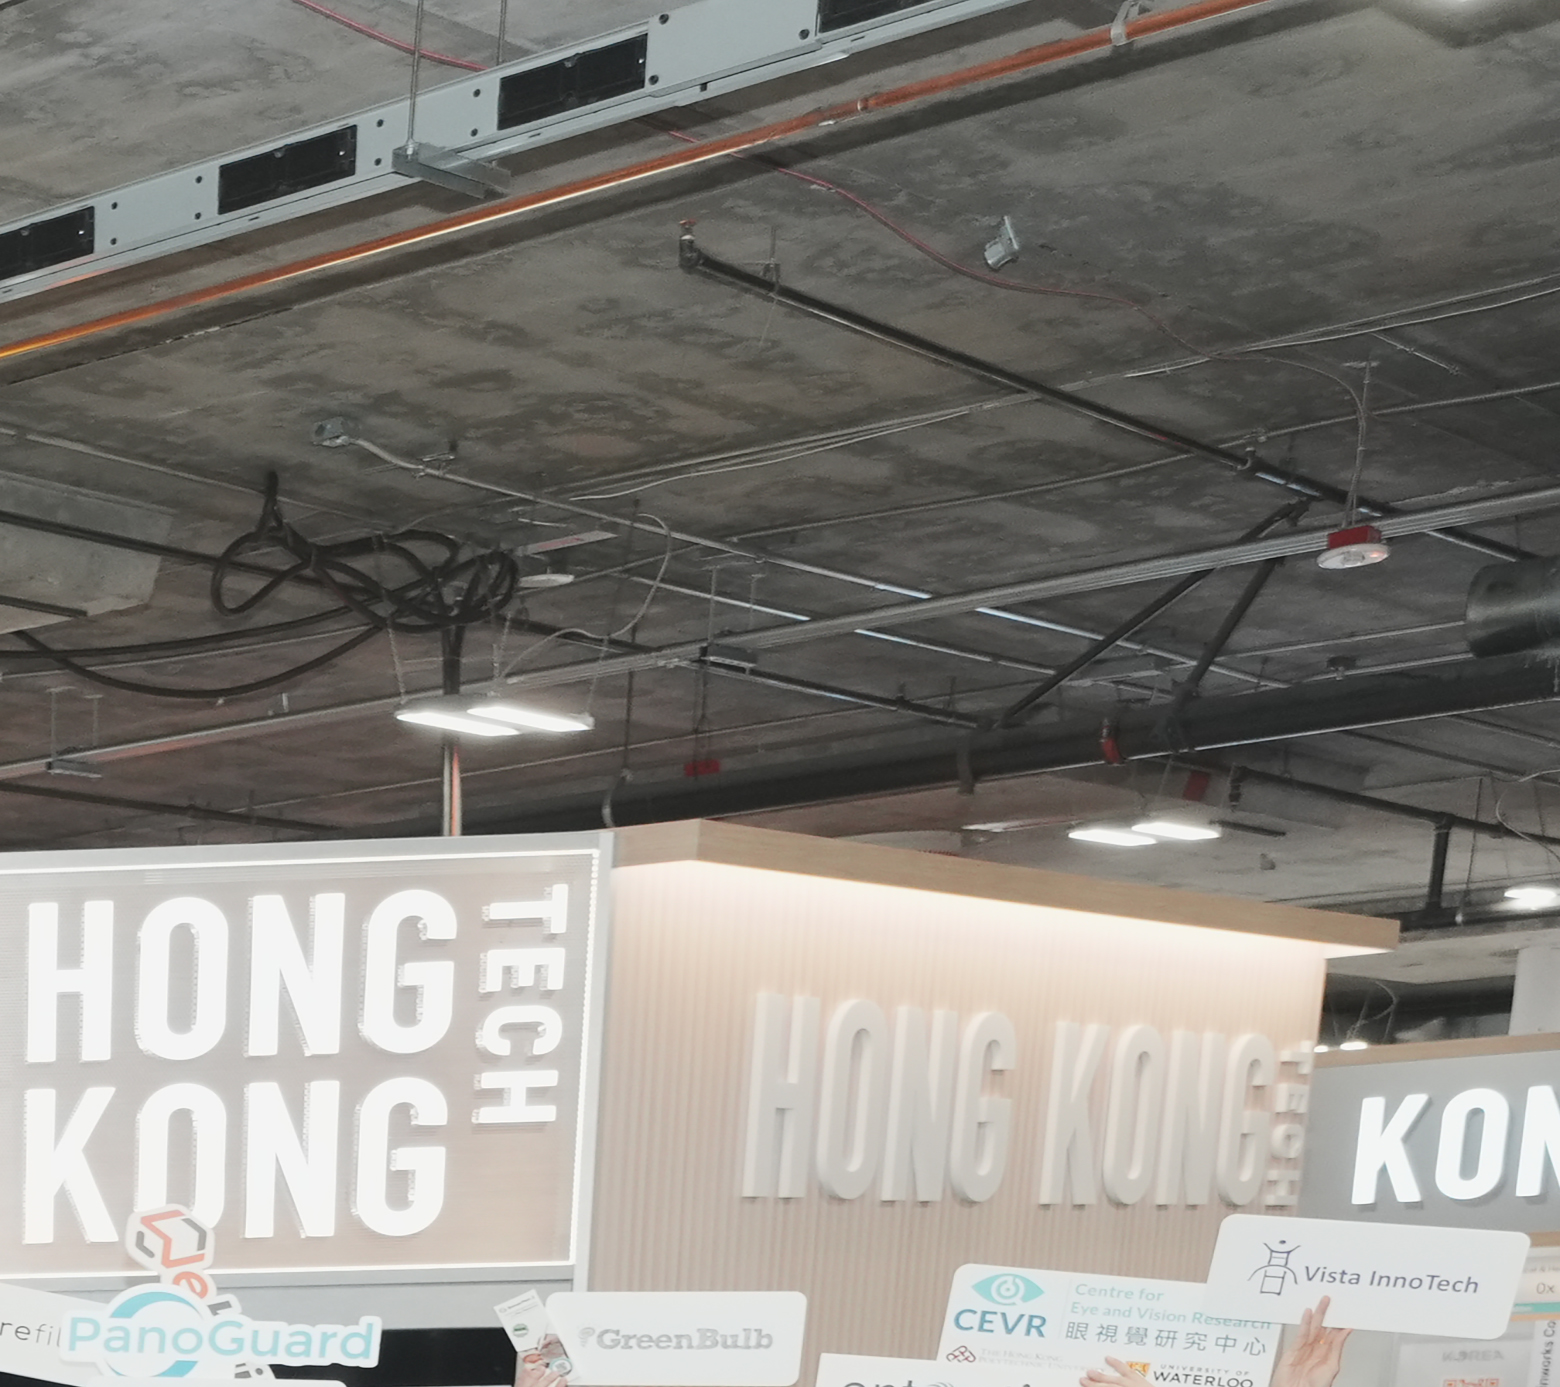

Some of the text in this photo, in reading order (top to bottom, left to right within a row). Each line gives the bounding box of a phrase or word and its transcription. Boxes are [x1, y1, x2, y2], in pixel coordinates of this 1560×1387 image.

[24, 890, 459, 1064] HONG
[477, 884, 569, 1126] TECH
[743, 993, 1268, 1208] HONG KONG
[1265, 1036, 1312, 1208] TECH
[21, 1077, 448, 1244] KONG
[1075, 1283, 1164, 1302] Centre for
[1304, 1265, 1480, 1295] Vista InnoTech
[953, 1308, 1048, 1338] CEVR
[1070, 1303, 1271, 1331] Eye and Vision Research
[67, 1315, 374, 1362] PanoGuard
[597, 1326, 774, 1351] GreenBulb
[1064, 1318, 1269, 1357] 眼視覺研究中心
[1160, 1363, 1230, 1376] UNIVERSITY
